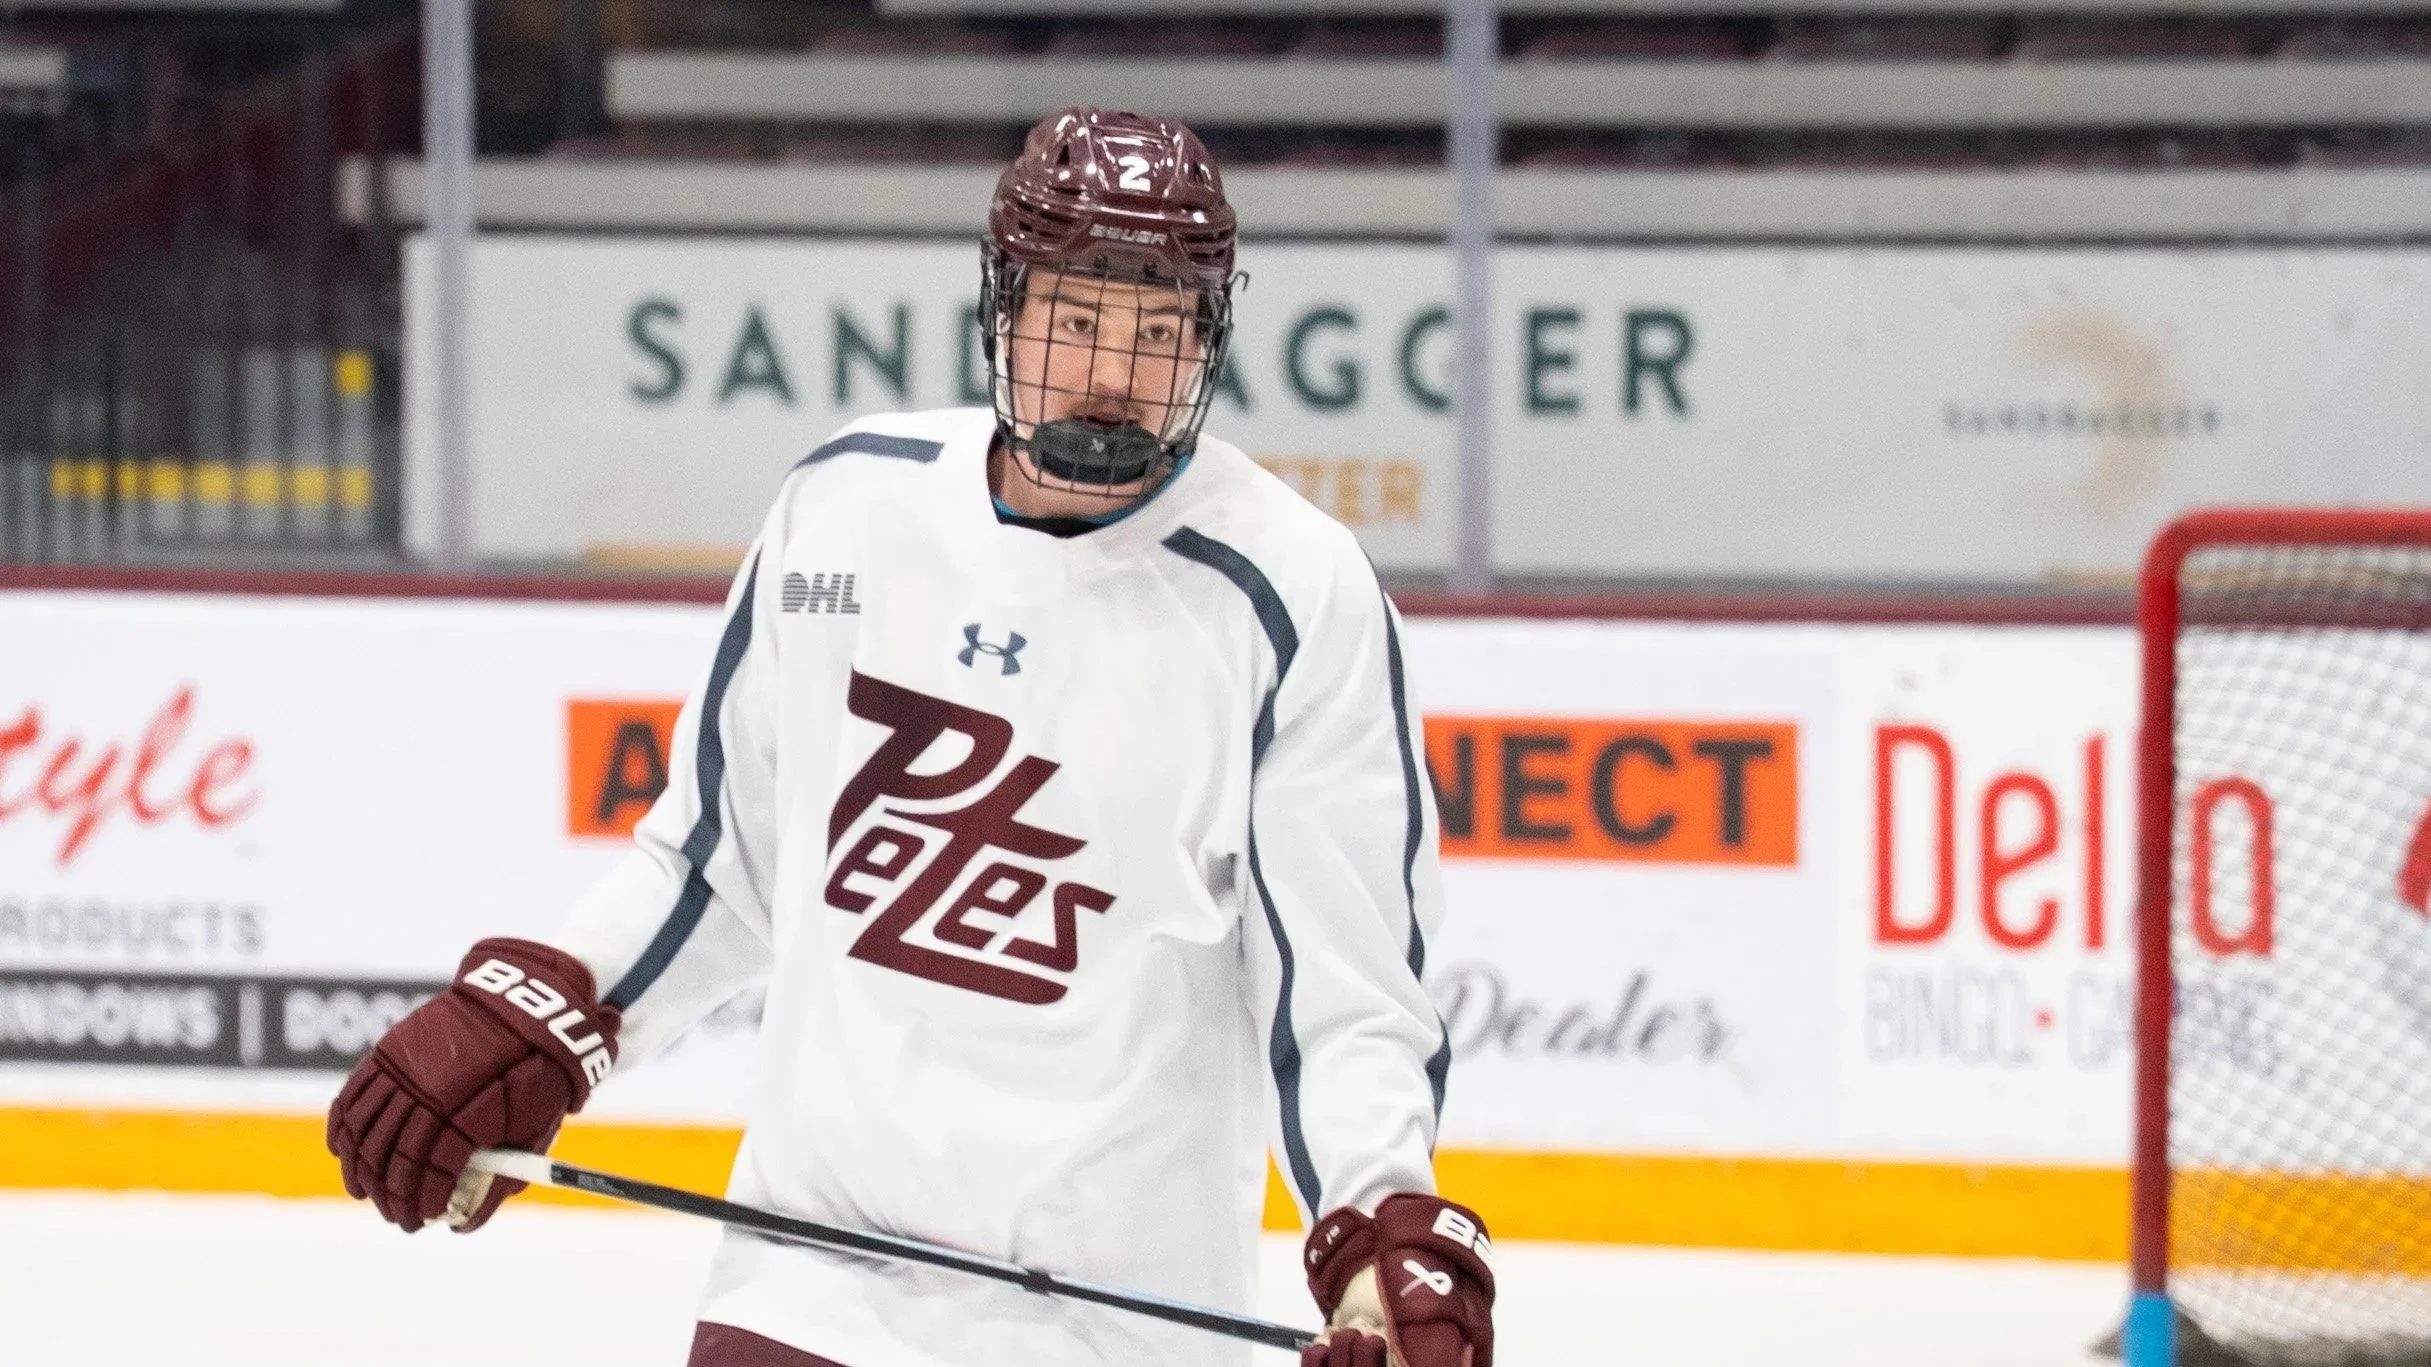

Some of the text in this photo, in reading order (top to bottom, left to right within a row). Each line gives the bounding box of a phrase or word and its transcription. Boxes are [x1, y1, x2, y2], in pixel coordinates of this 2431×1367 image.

[1118, 155, 1151, 192] 2
[627, 300, 1697, 412] SANGGER
[1875, 724, 2274, 957] Dela
[284, 988, 438, 1052] DOO
